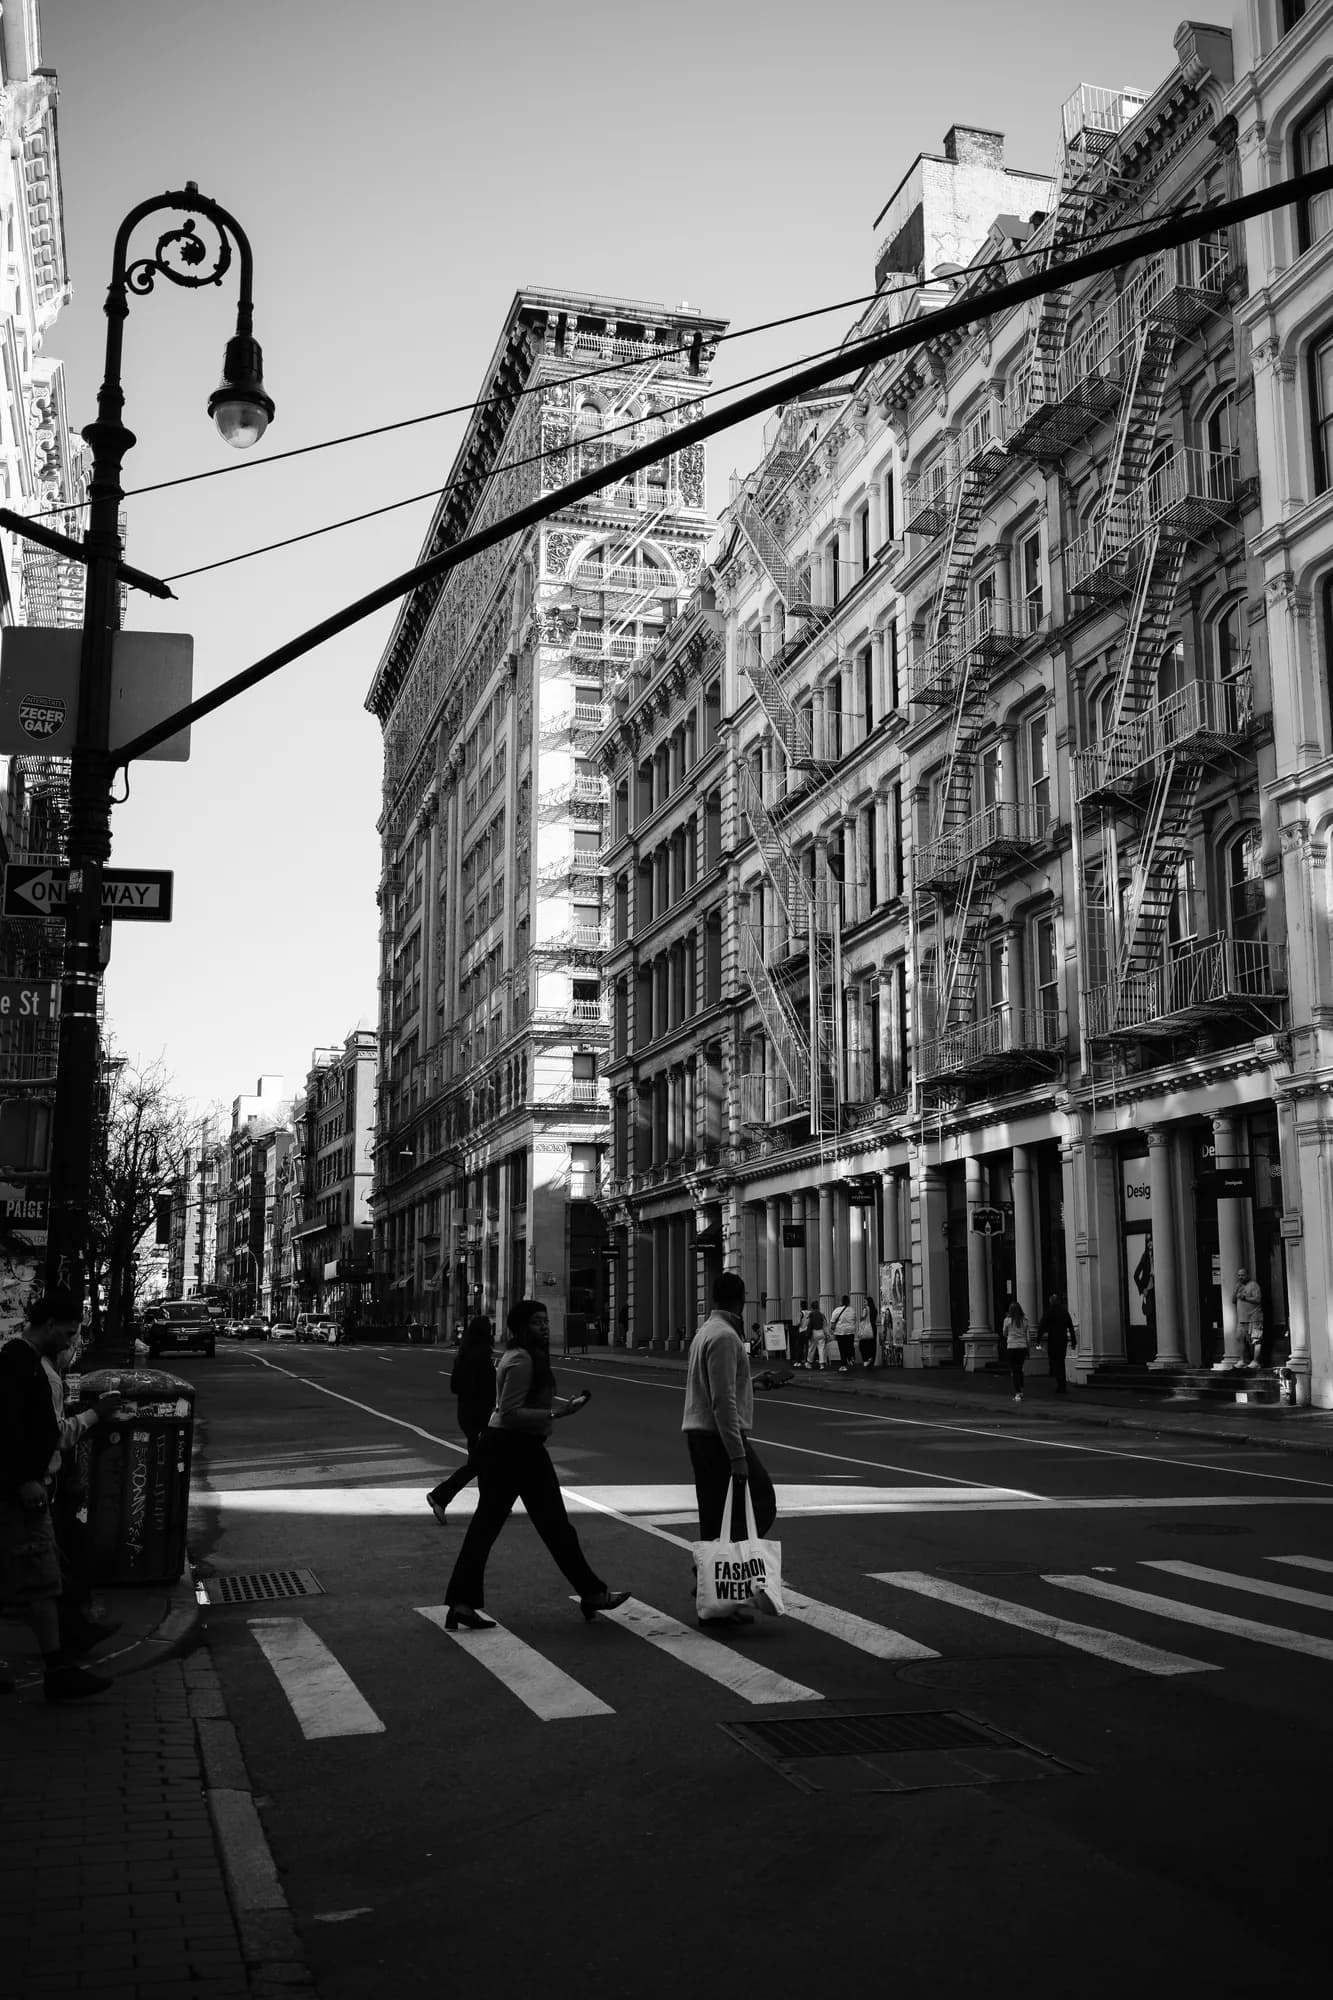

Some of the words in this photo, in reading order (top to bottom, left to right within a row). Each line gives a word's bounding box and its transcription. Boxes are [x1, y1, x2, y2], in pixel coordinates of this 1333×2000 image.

[20, 706, 64, 723] ZECER
[24, 719, 55, 734] GAK
[32, 882, 68, 901] ON
[101, 884, 150, 905] WAY
[19, 990, 40, 1016] St
[6, 1200, 45, 1218] PAIGE
[715, 1580, 754, 1600] WEEK
